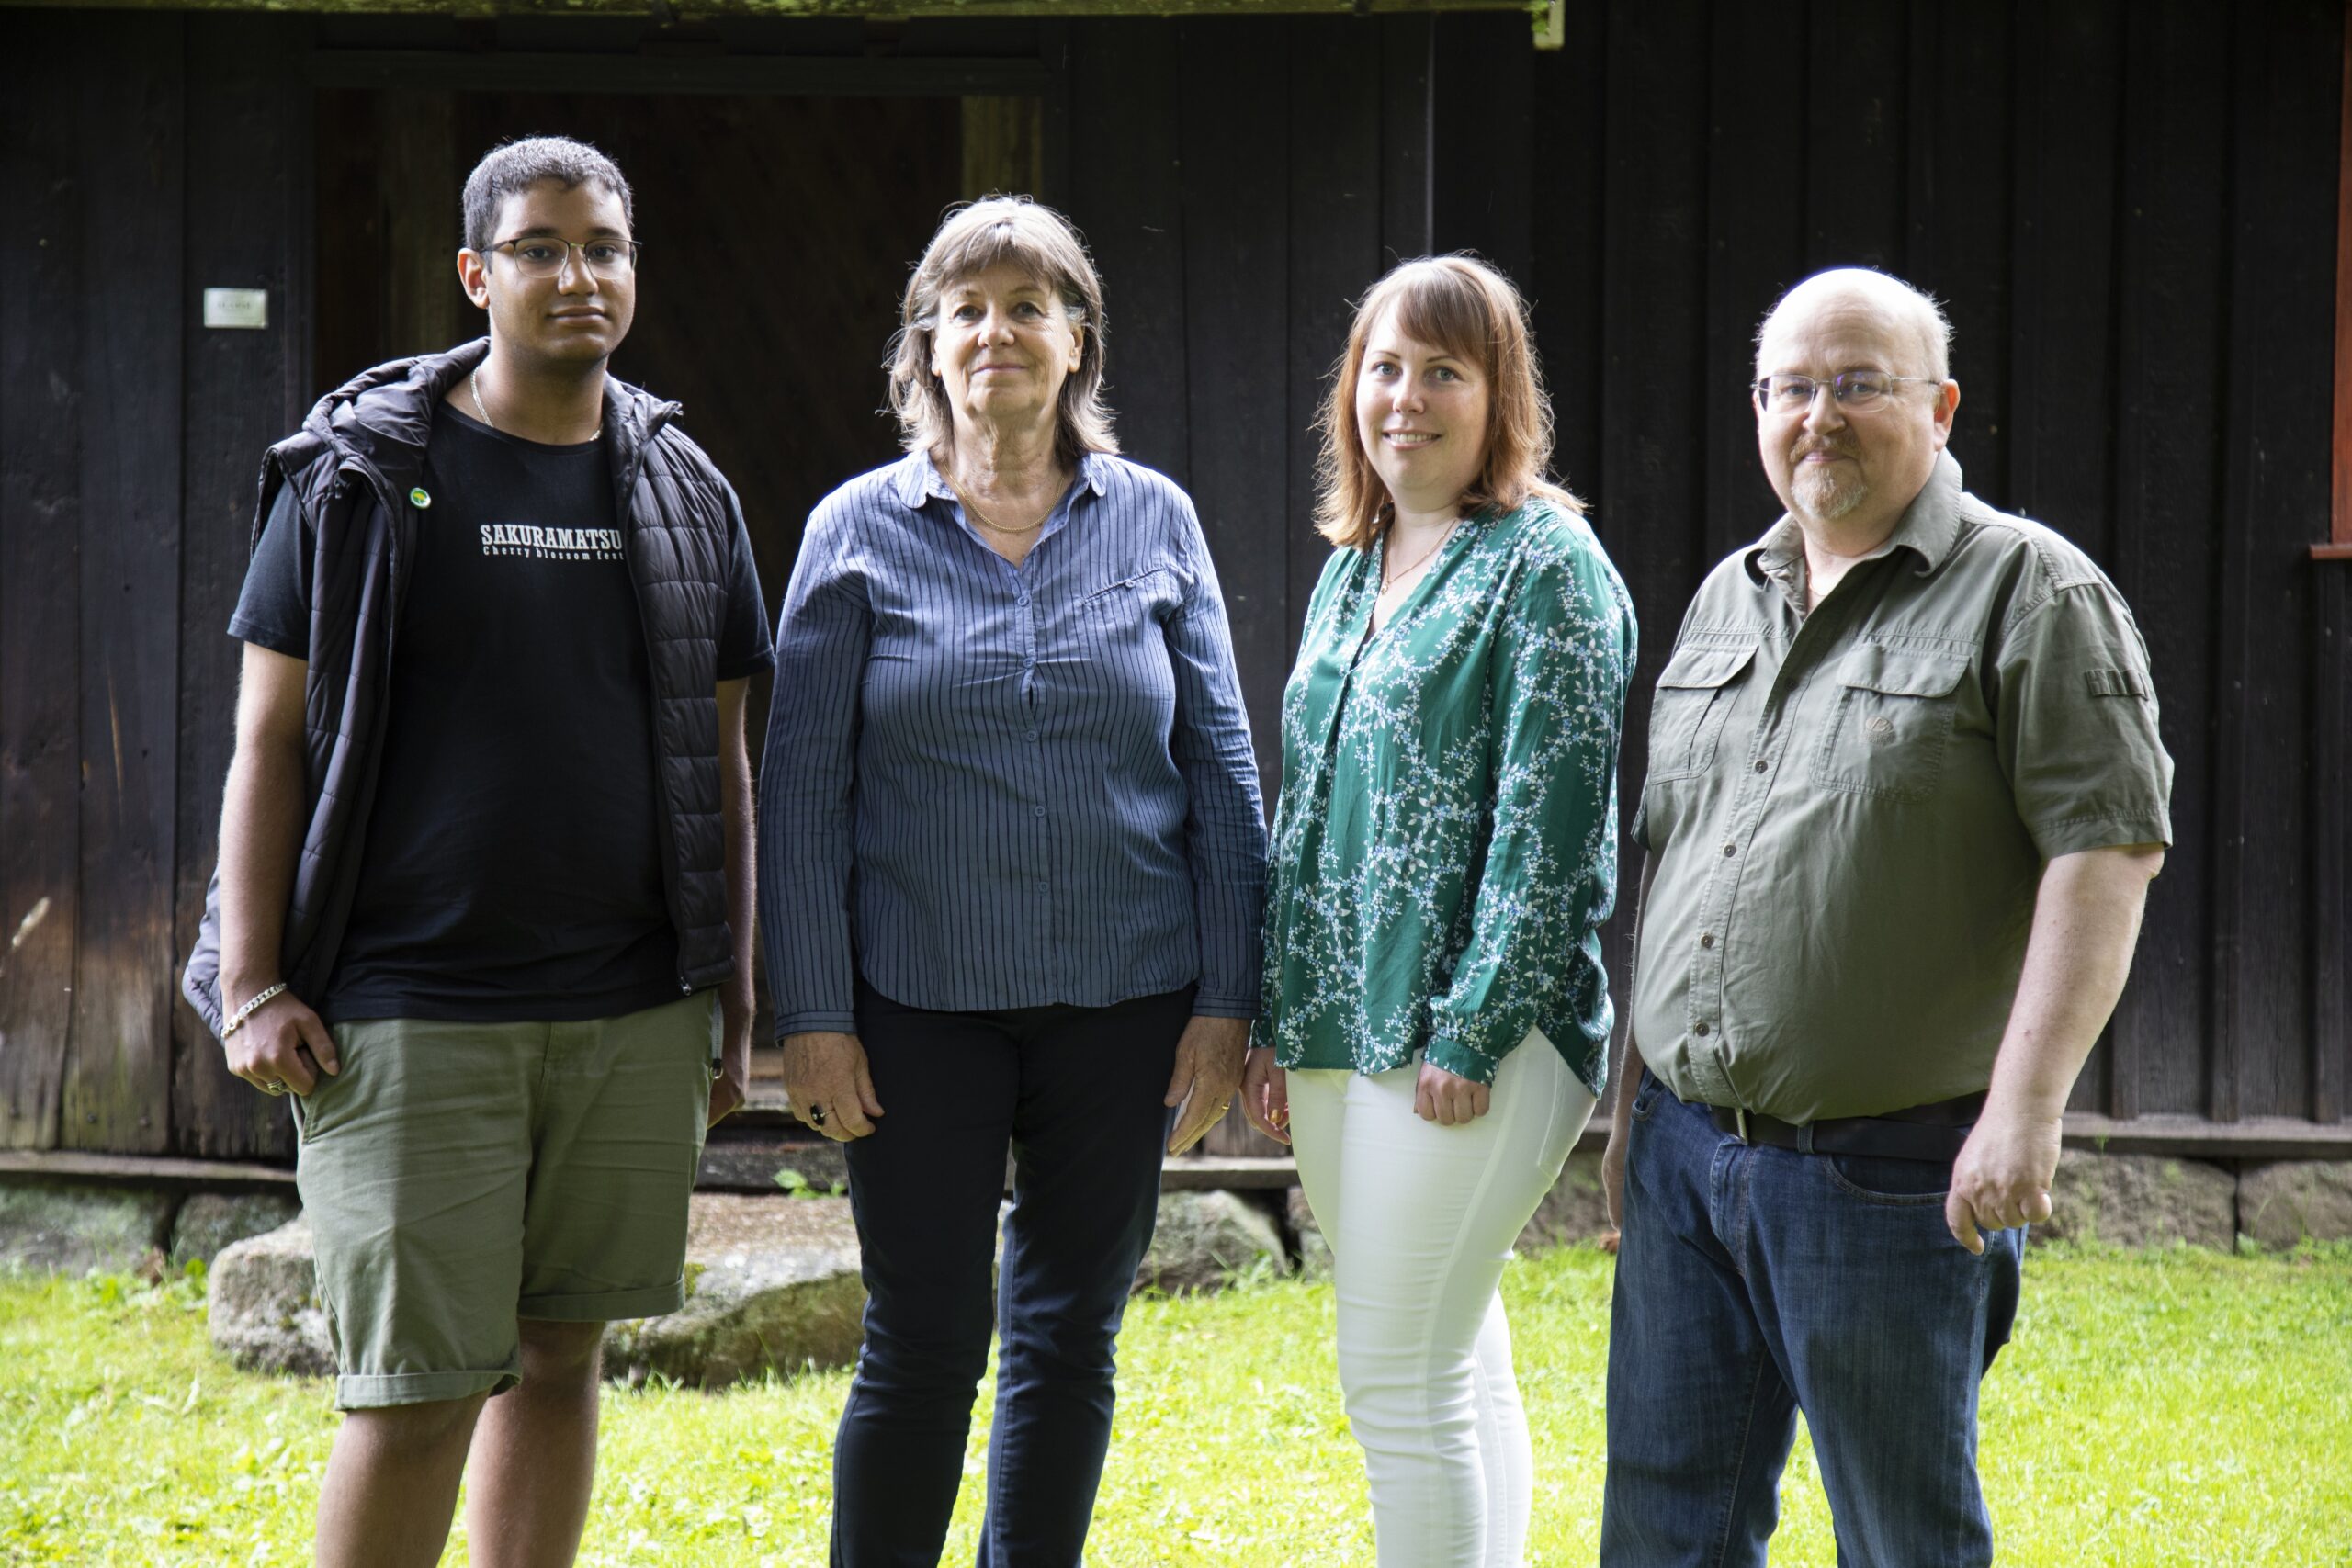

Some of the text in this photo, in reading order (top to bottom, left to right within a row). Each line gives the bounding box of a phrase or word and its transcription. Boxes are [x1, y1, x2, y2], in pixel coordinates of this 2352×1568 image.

[480, 524, 623, 550] SAKURAMATSU
[482, 546, 530, 558] Cherry
[536, 547, 591, 560] blossom
